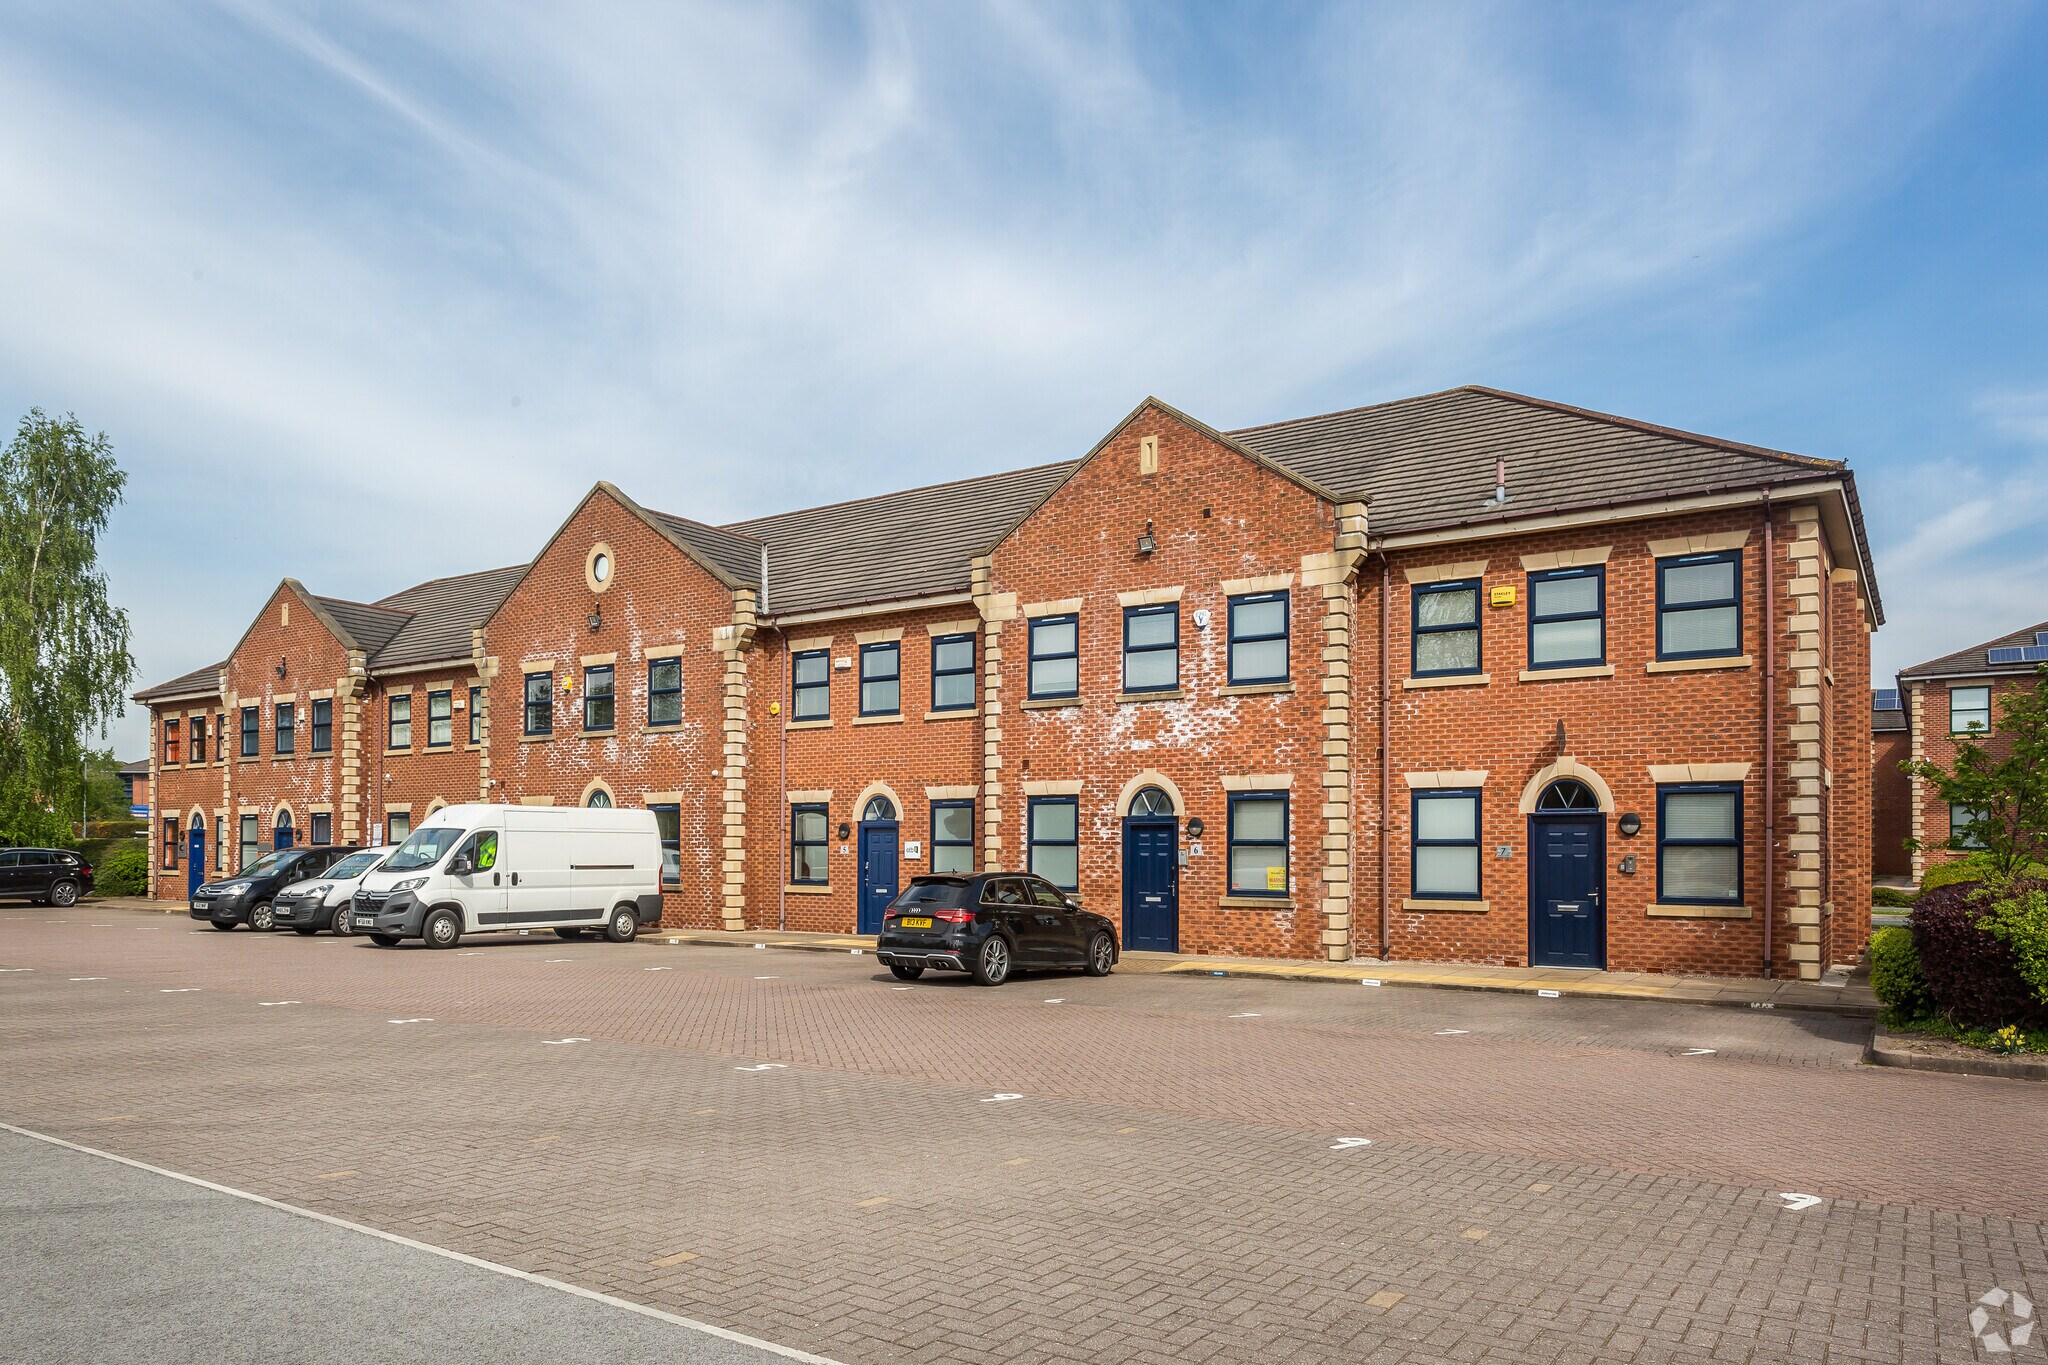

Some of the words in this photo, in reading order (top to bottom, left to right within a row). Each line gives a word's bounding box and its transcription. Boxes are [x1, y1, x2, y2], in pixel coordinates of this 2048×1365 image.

[1193, 846, 1199, 854] 6
[1500, 847, 1506, 856] 7
[906, 918, 915, 926] B13
[916, 918, 927, 927] KVF
[1681, 1048, 1717, 1056] 7
